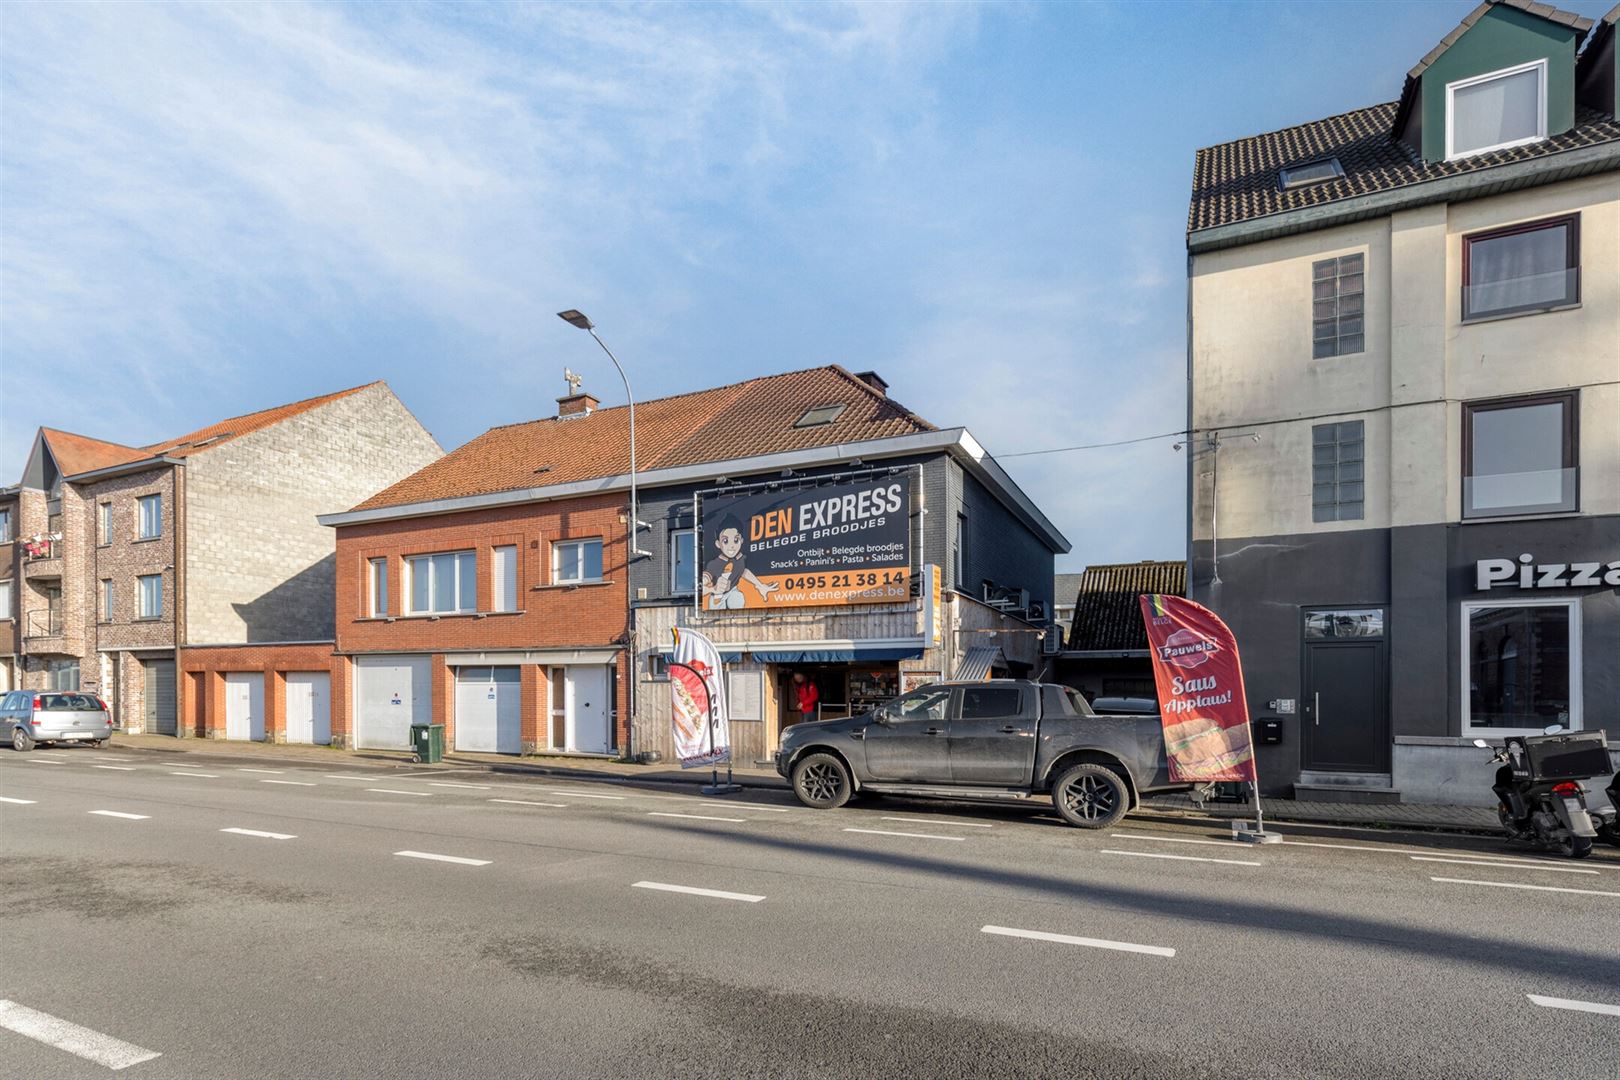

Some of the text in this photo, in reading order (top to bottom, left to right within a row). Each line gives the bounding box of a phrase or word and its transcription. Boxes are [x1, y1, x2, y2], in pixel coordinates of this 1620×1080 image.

[750, 483, 902, 541] DEN EXPRESS
[750, 517, 886, 552] BELEGDE BROODJES
[797, 542, 904, 558] Ontbijt Belegde broodjes
[770, 553, 904, 569] Snack's Panini's Pasta Salades
[785, 572, 904, 590] 0495 21 38 14
[774, 586, 905, 601] www.denexpress.be
[1164, 642, 1213, 657] Pauwels
[1171, 675, 1217, 695] Saus
[1164, 691, 1232, 713] Applaus!
